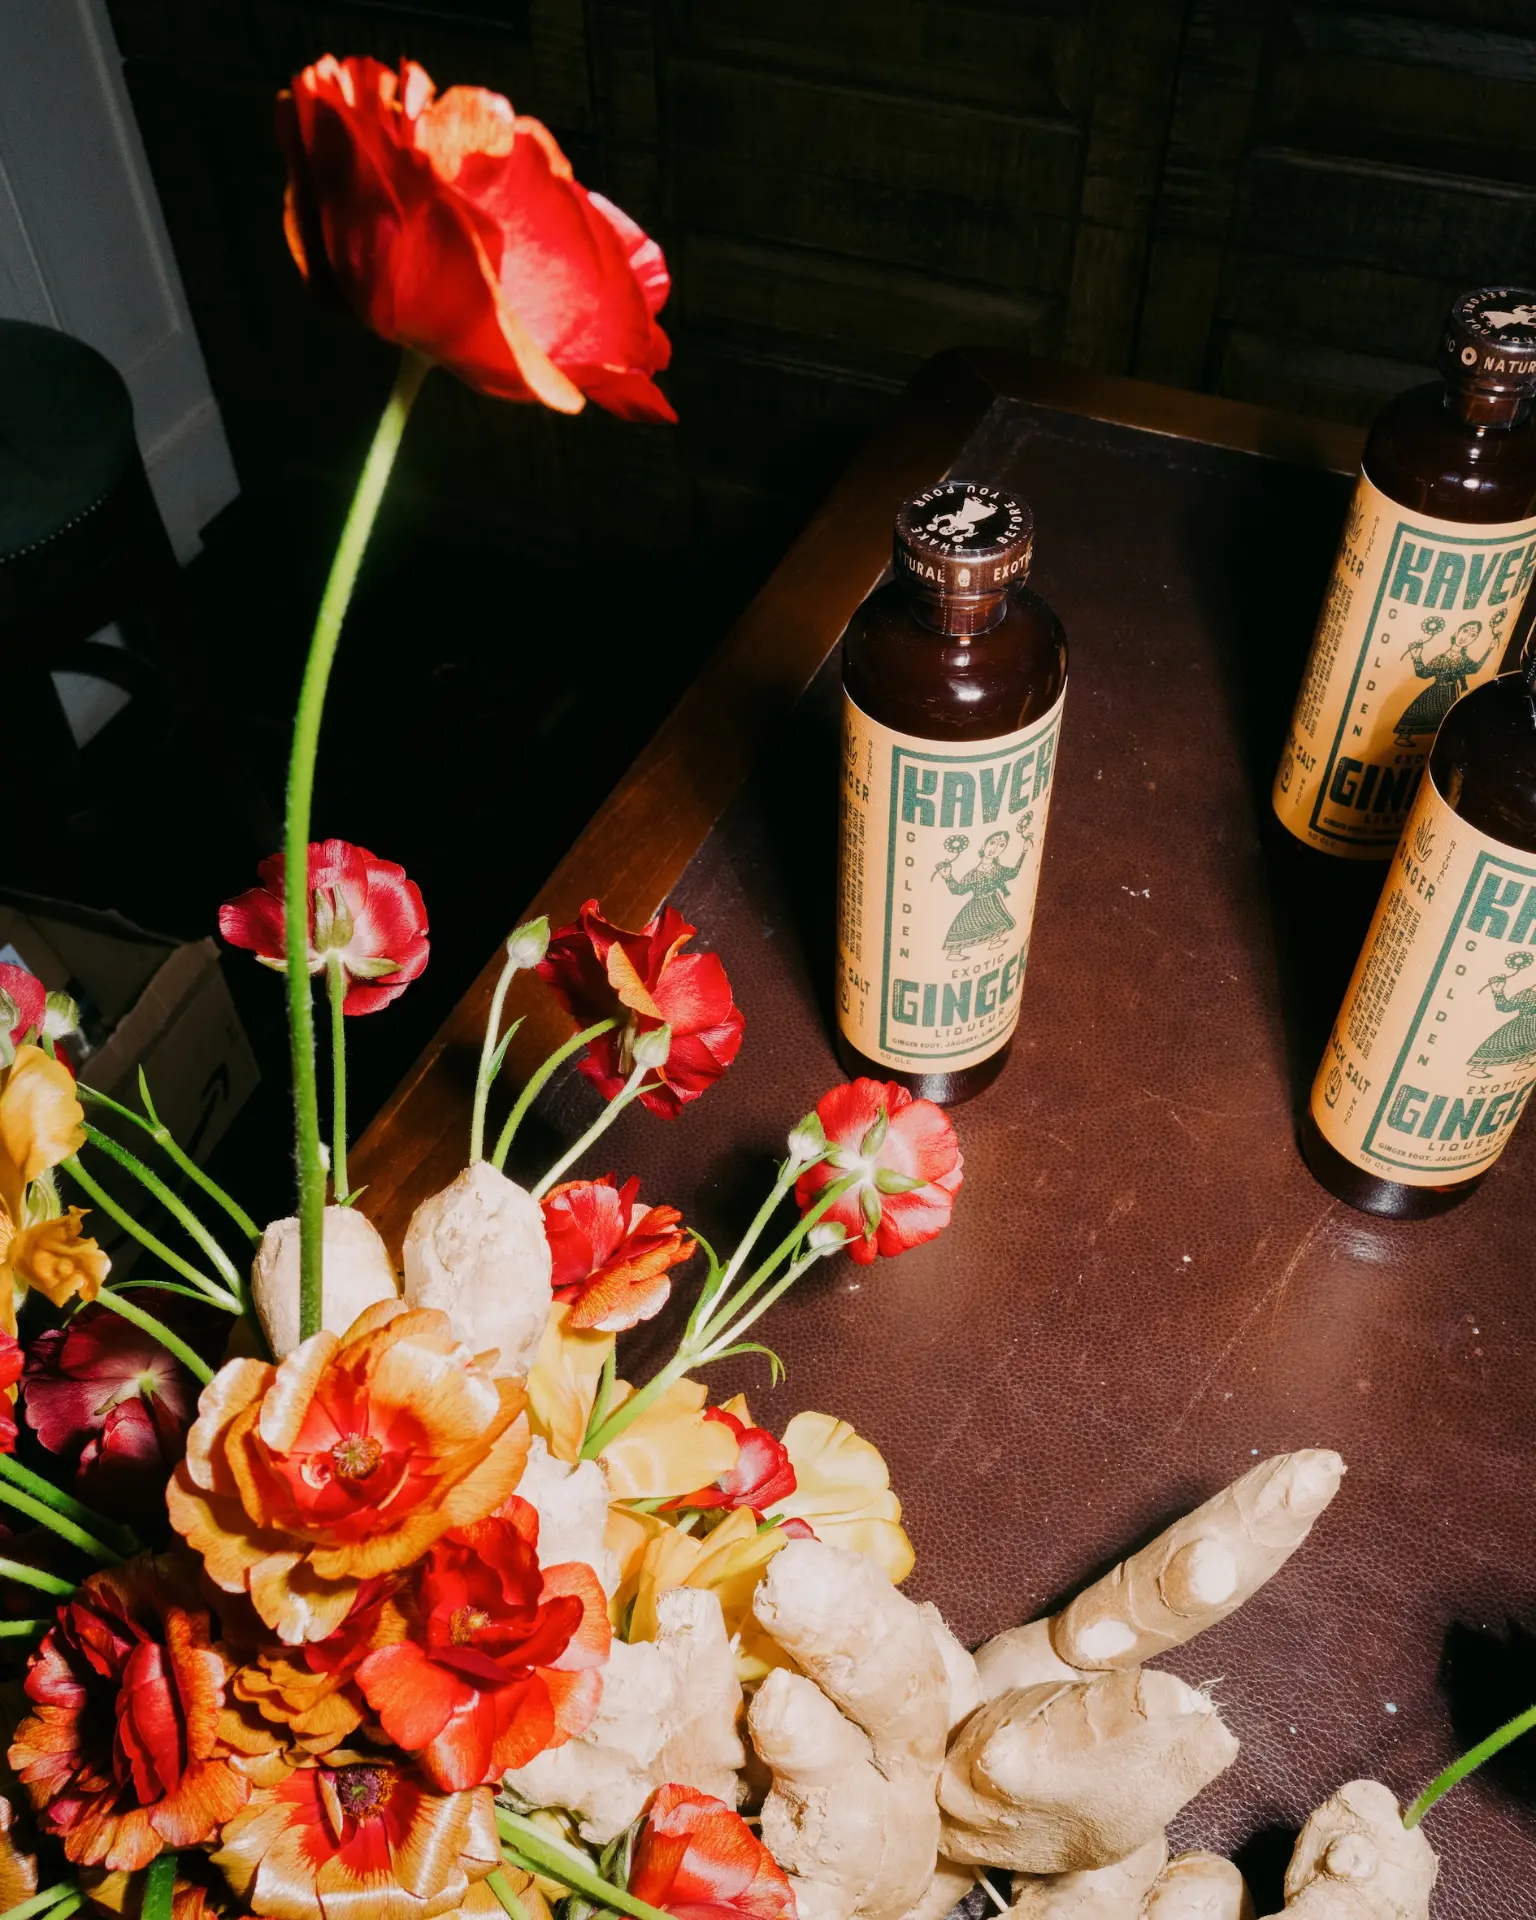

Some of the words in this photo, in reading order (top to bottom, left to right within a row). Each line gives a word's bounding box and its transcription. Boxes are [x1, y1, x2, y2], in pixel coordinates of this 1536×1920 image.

[1466, 319, 1490, 335] YOU
[1500, 334, 1536, 344] POU
[913, 485, 954, 507] POUR
[967, 485, 1000, 499] YOU
[996, 501, 1022, 544] BEFORE
[911, 526, 963, 553] SHAKE
[1353, 608, 1398, 737] GOLDEN
[1437, 840, 1457, 884] RITUAL
[899, 831, 916, 958] GOLDEN
[952, 953, 1005, 979] EXOTIC
[848, 967, 870, 995] SALT
[1417, 940, 1477, 1067] GOLDEN
[935, 1007, 1004, 1038] LIQUEUR
[1369, 1028, 1376, 1038] TO
[1345, 1062, 1371, 1095] SALT
[1466, 1076, 1527, 1095] EXOTIC
[1344, 1097, 1357, 1125] MADE
[1378, 1142, 1406, 1157] GINGER
[1428, 1129, 1506, 1151] LIQUEUR
